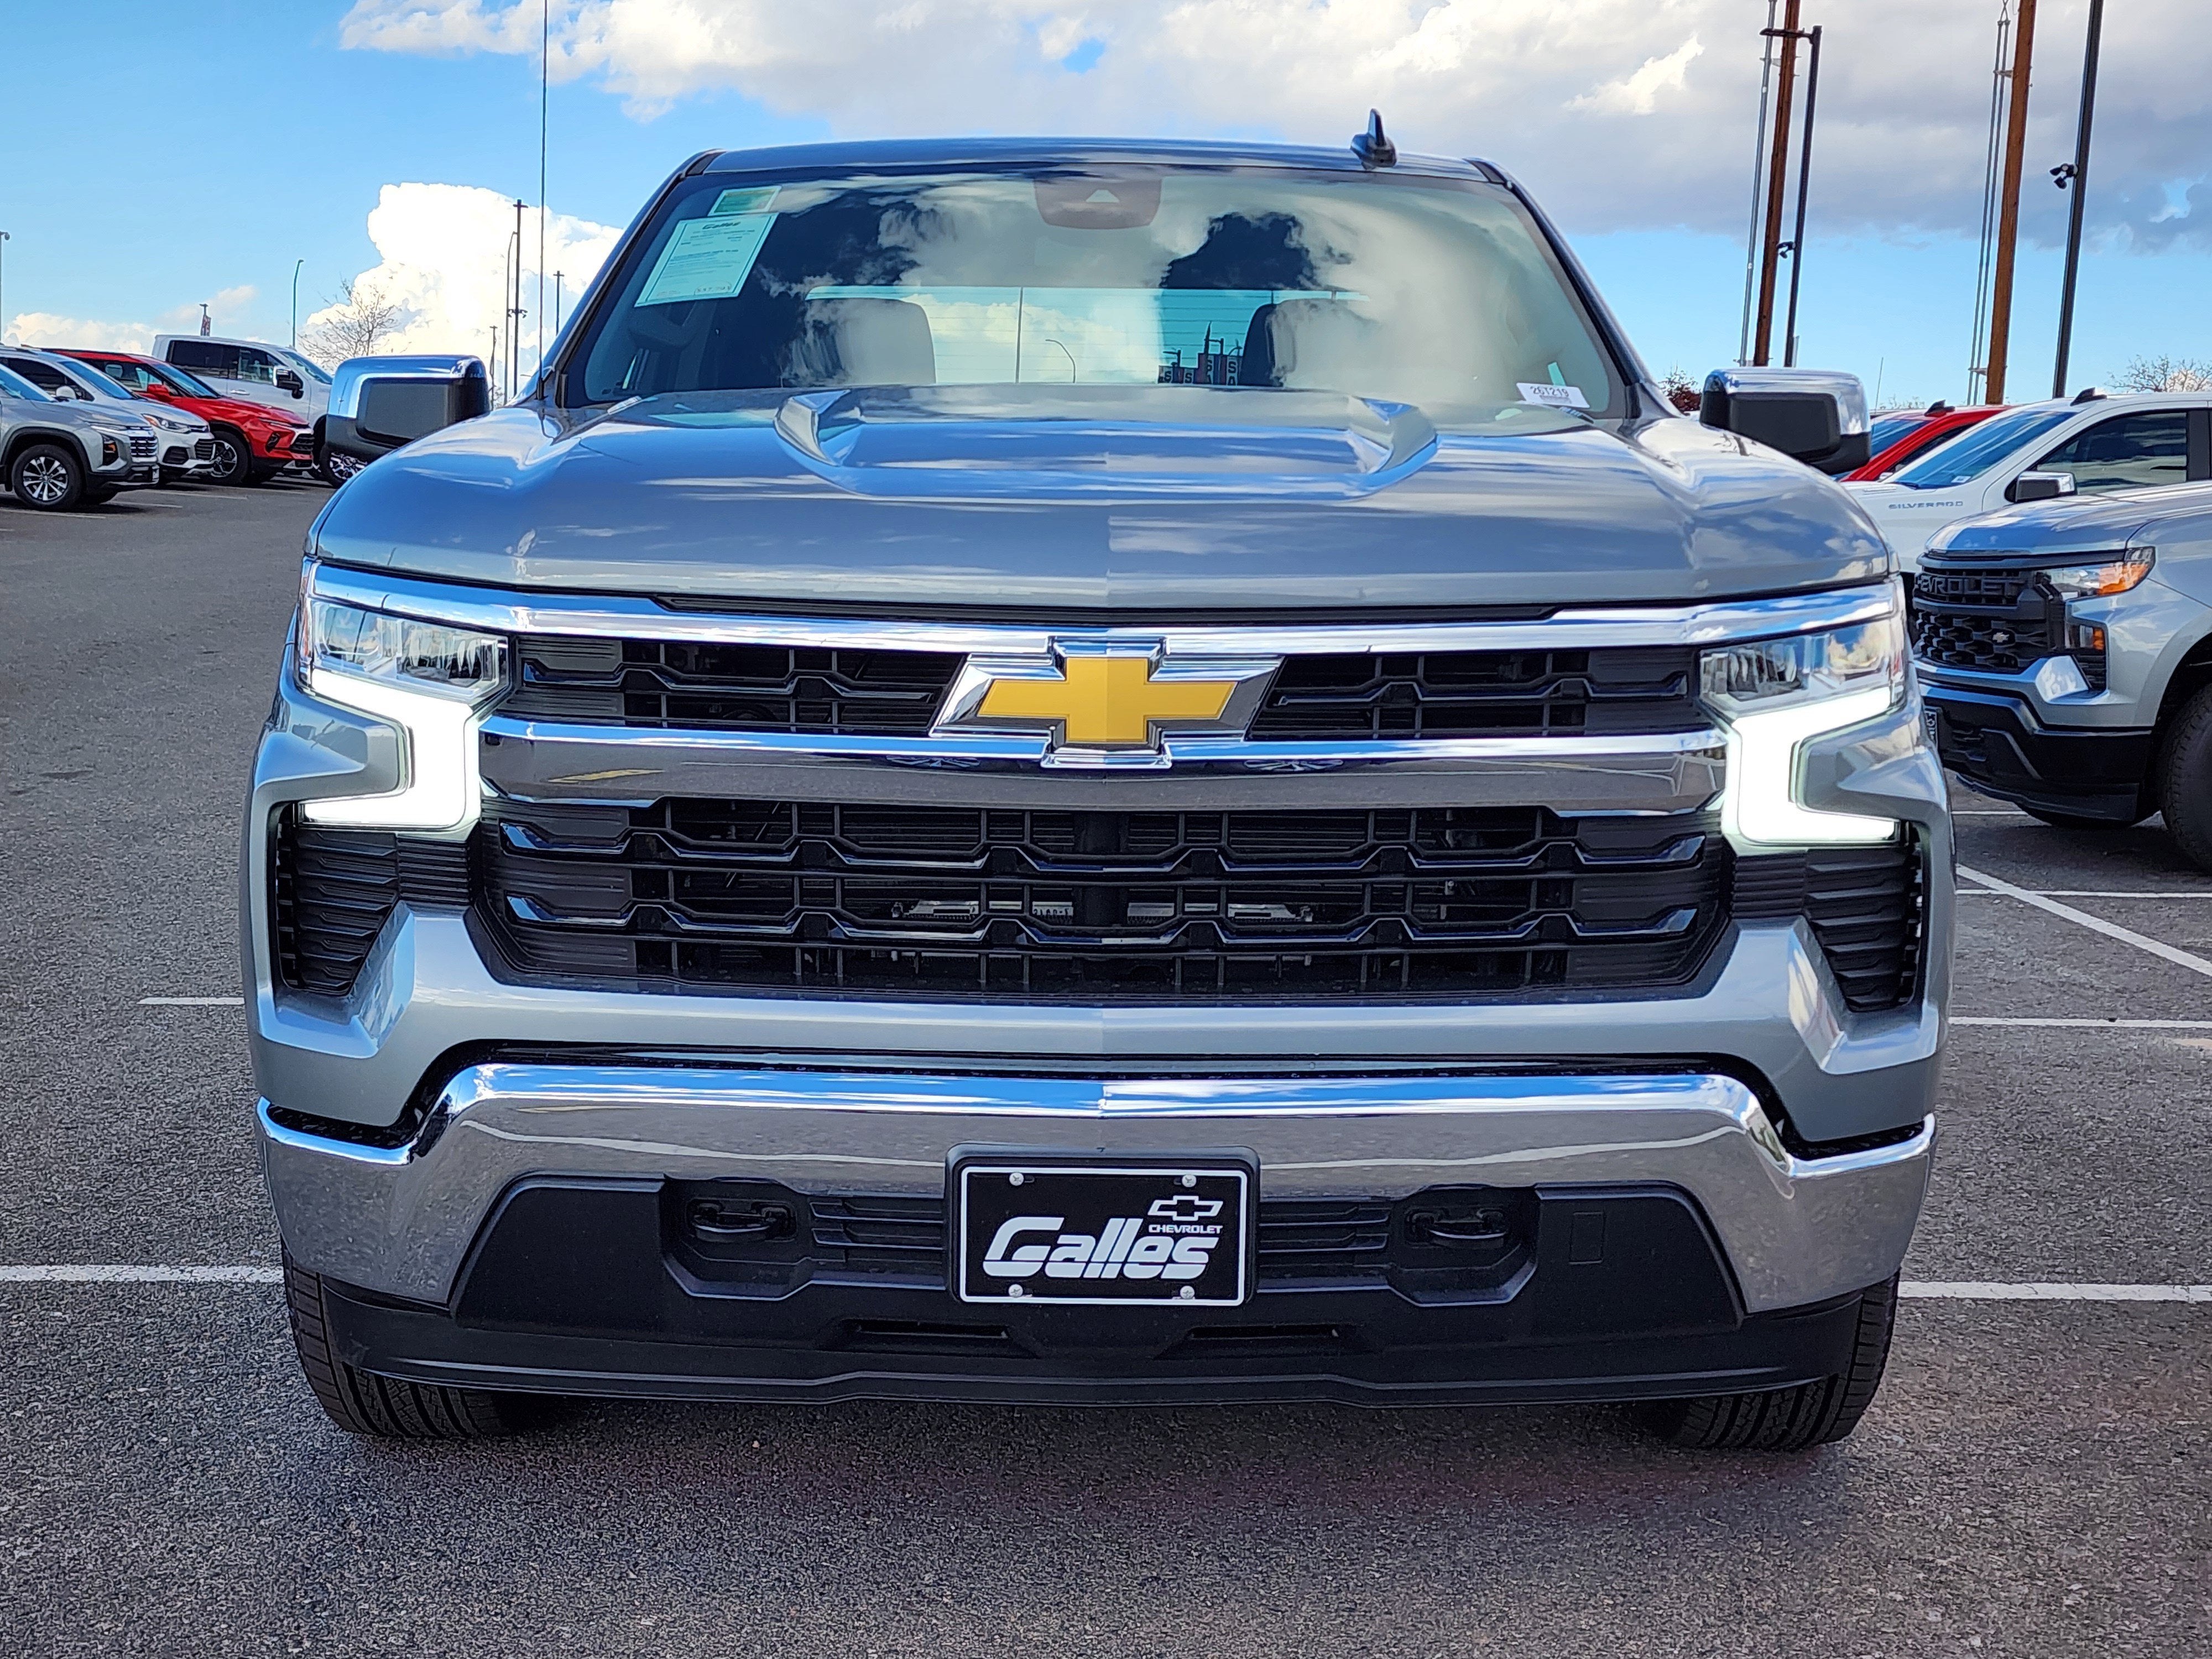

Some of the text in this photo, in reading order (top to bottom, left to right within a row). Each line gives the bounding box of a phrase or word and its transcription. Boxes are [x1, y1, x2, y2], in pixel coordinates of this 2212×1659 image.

[1888, 500, 1963, 509] SILVERADO
[1149, 1224, 1223, 1234] CHEVROLET
[983, 1216, 1219, 1279] Galles
